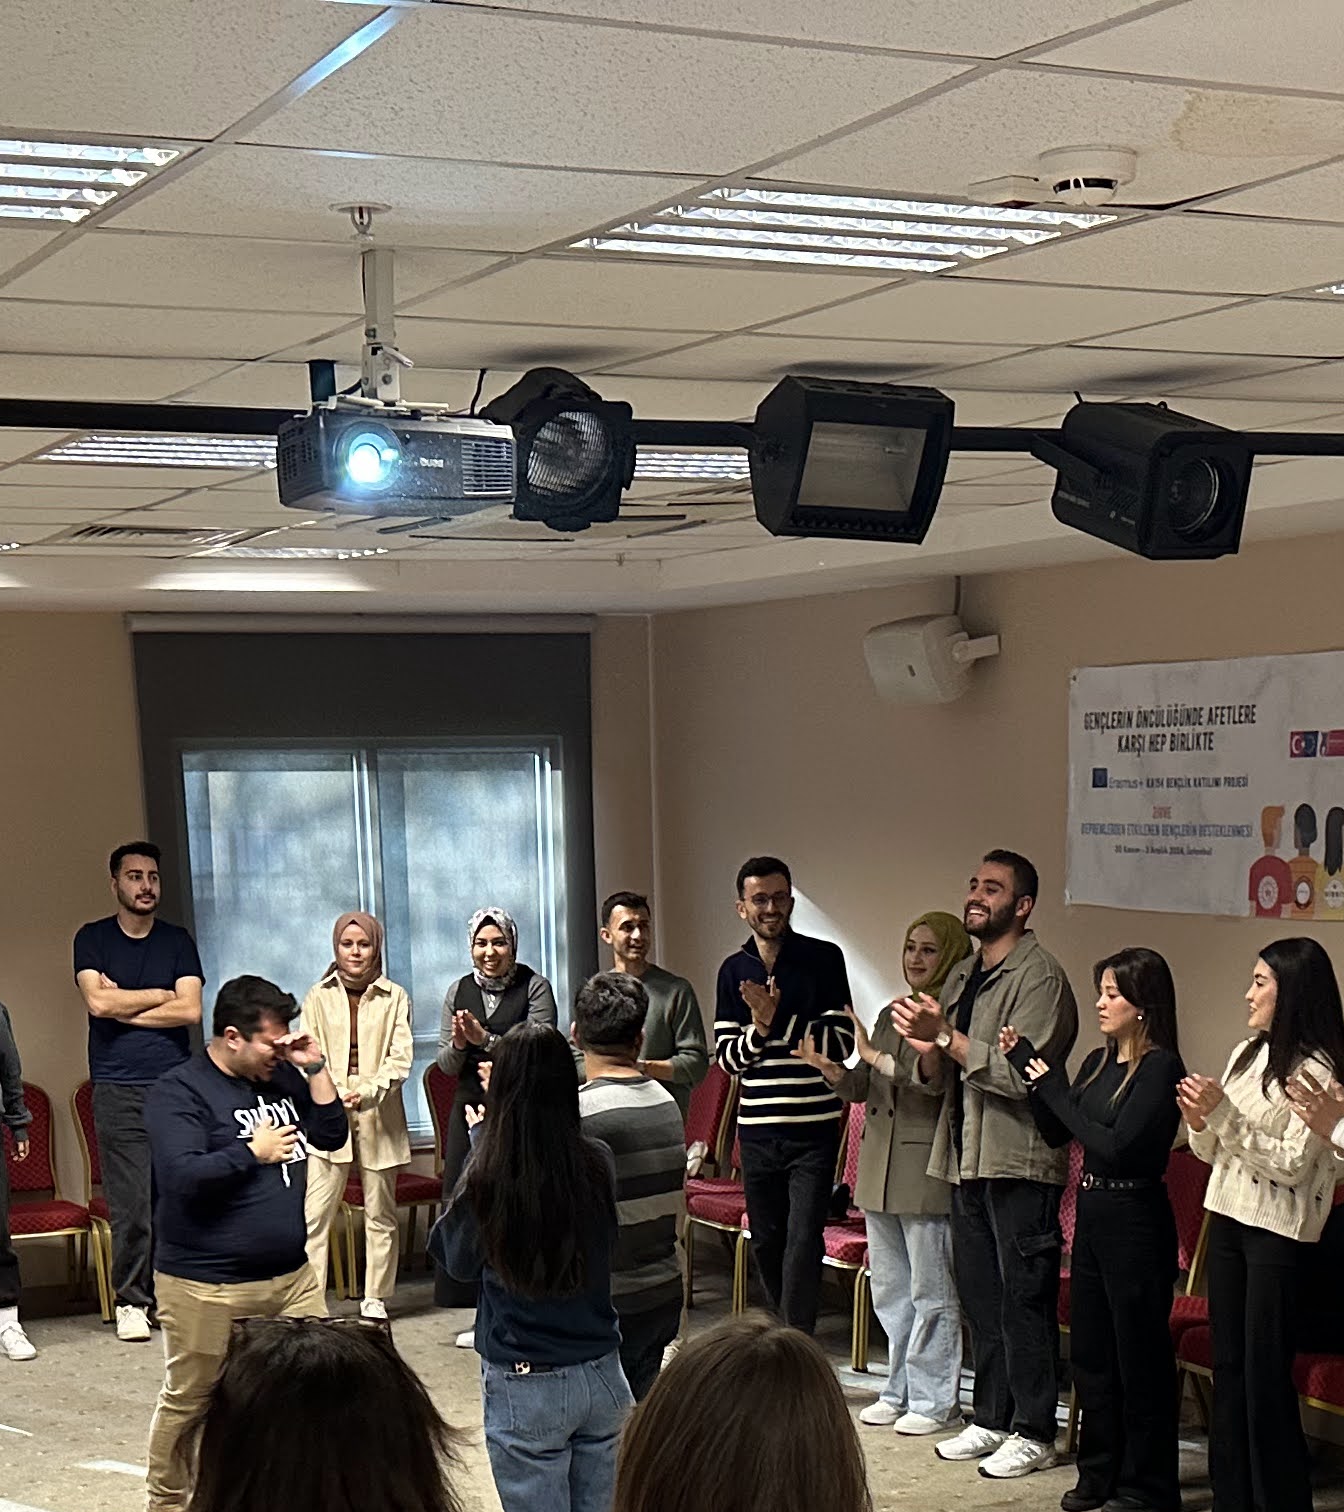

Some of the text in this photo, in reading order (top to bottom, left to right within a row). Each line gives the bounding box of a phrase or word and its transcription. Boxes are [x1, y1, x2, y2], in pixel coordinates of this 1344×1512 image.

[1084, 703, 1257, 735] GENÇLERİN ÖNCÜLÜĞÜNDE AFETLERE
[1118, 728, 1214, 757] KARŞI HEP BİRLİKTE
[1223, 774, 1248, 788] PROJESİ
